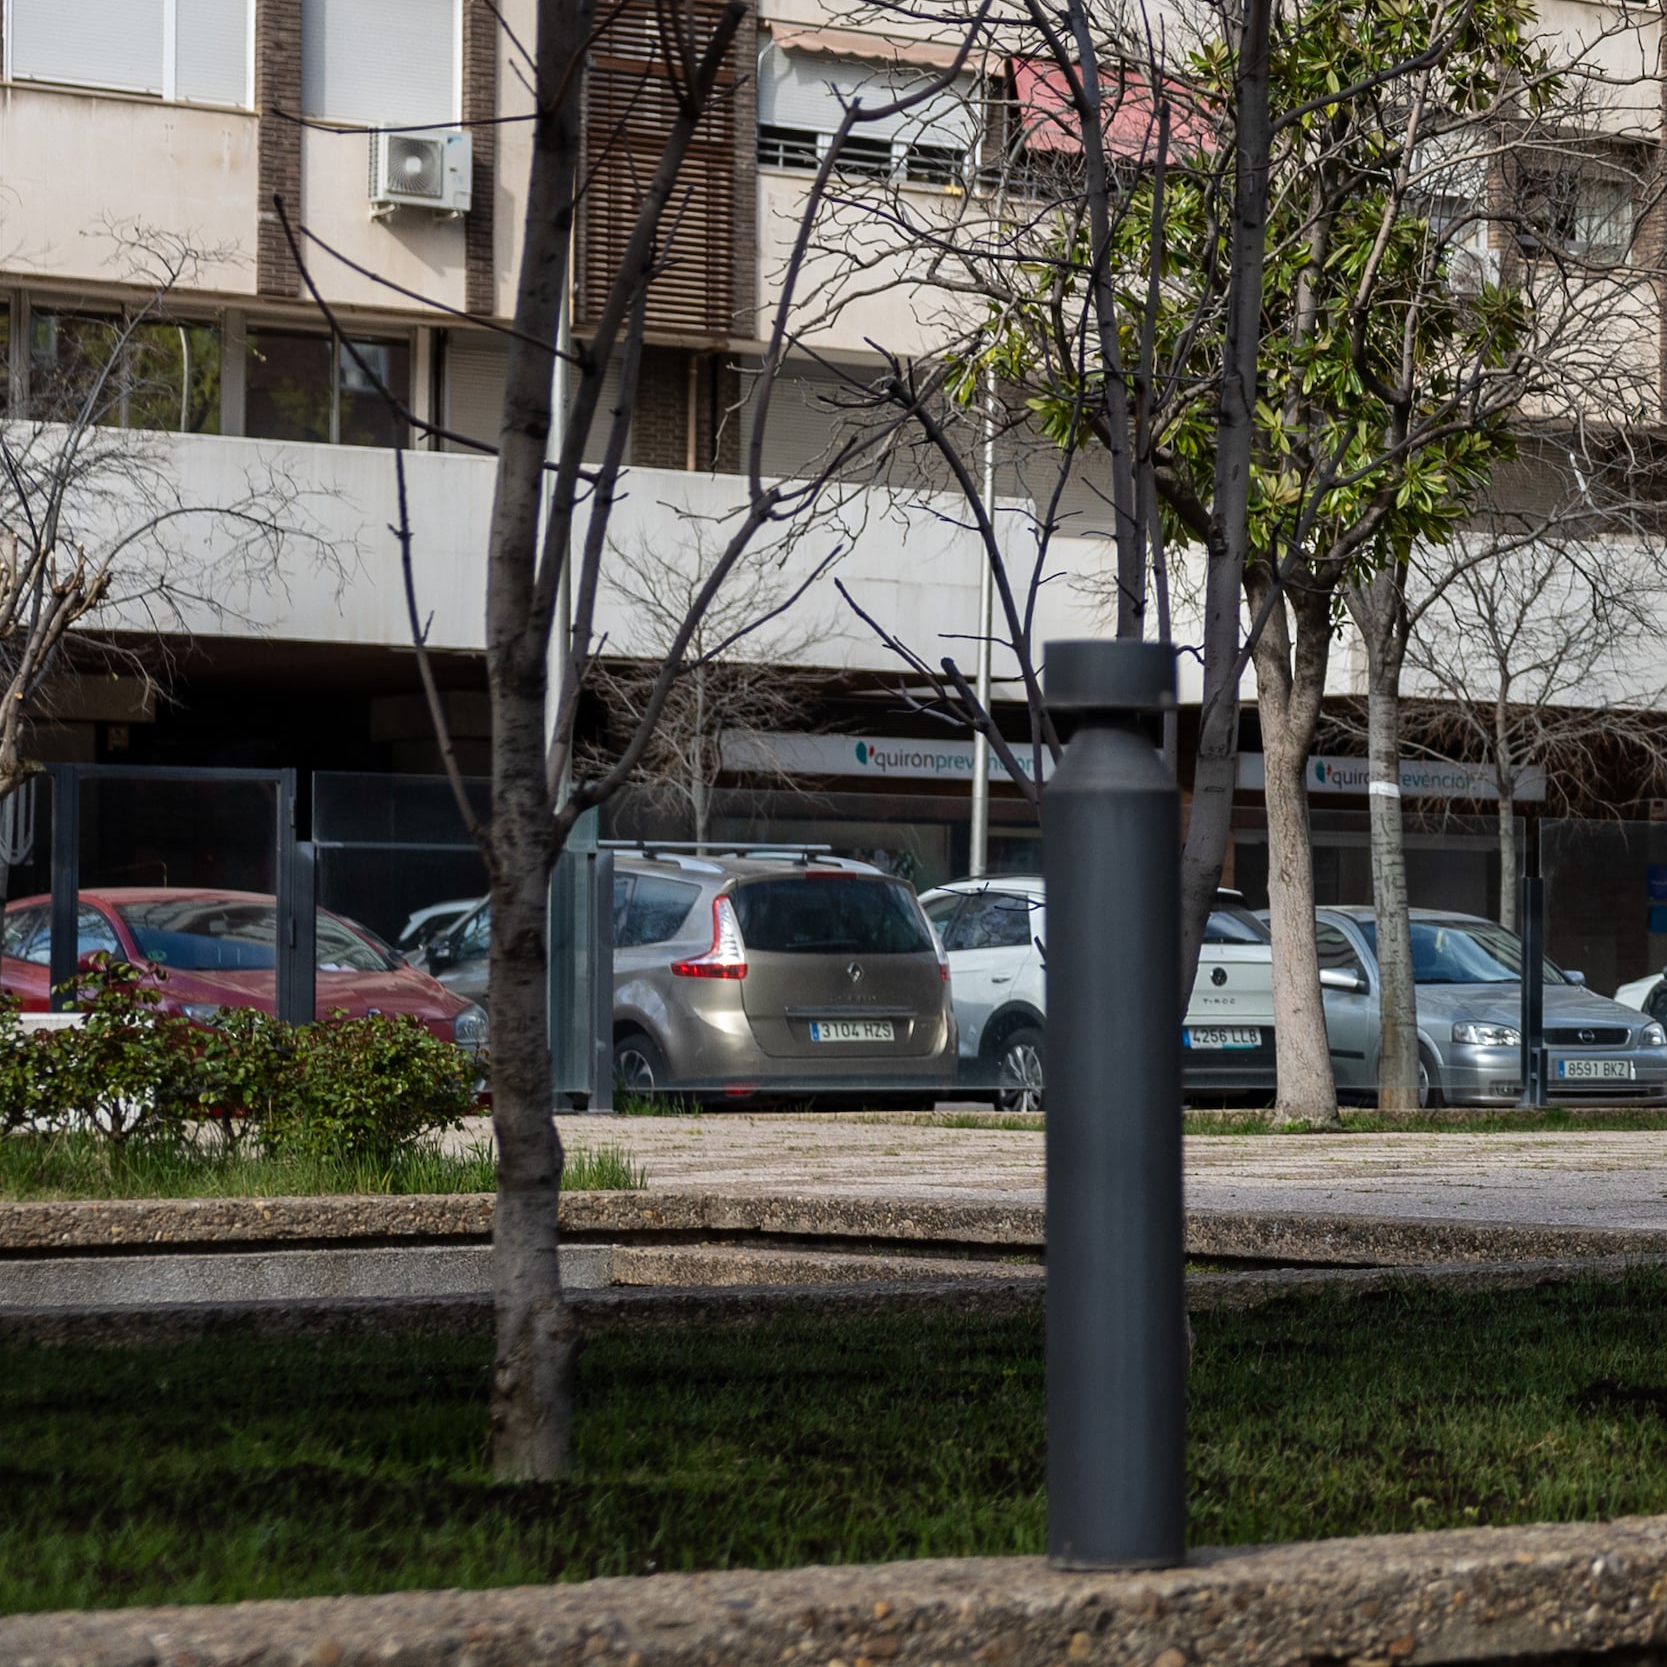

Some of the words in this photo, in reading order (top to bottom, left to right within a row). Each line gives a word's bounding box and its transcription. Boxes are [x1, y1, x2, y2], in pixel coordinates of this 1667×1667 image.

[821, 1022, 860, 1039] 3104
[864, 1021, 891, 1038] HZS
[1193, 1028, 1228, 1044] 4256
[1231, 1028, 1258, 1043] LLB
[1568, 1062, 1599, 1076] 8591
[1603, 1062, 1625, 1076] BKZ
